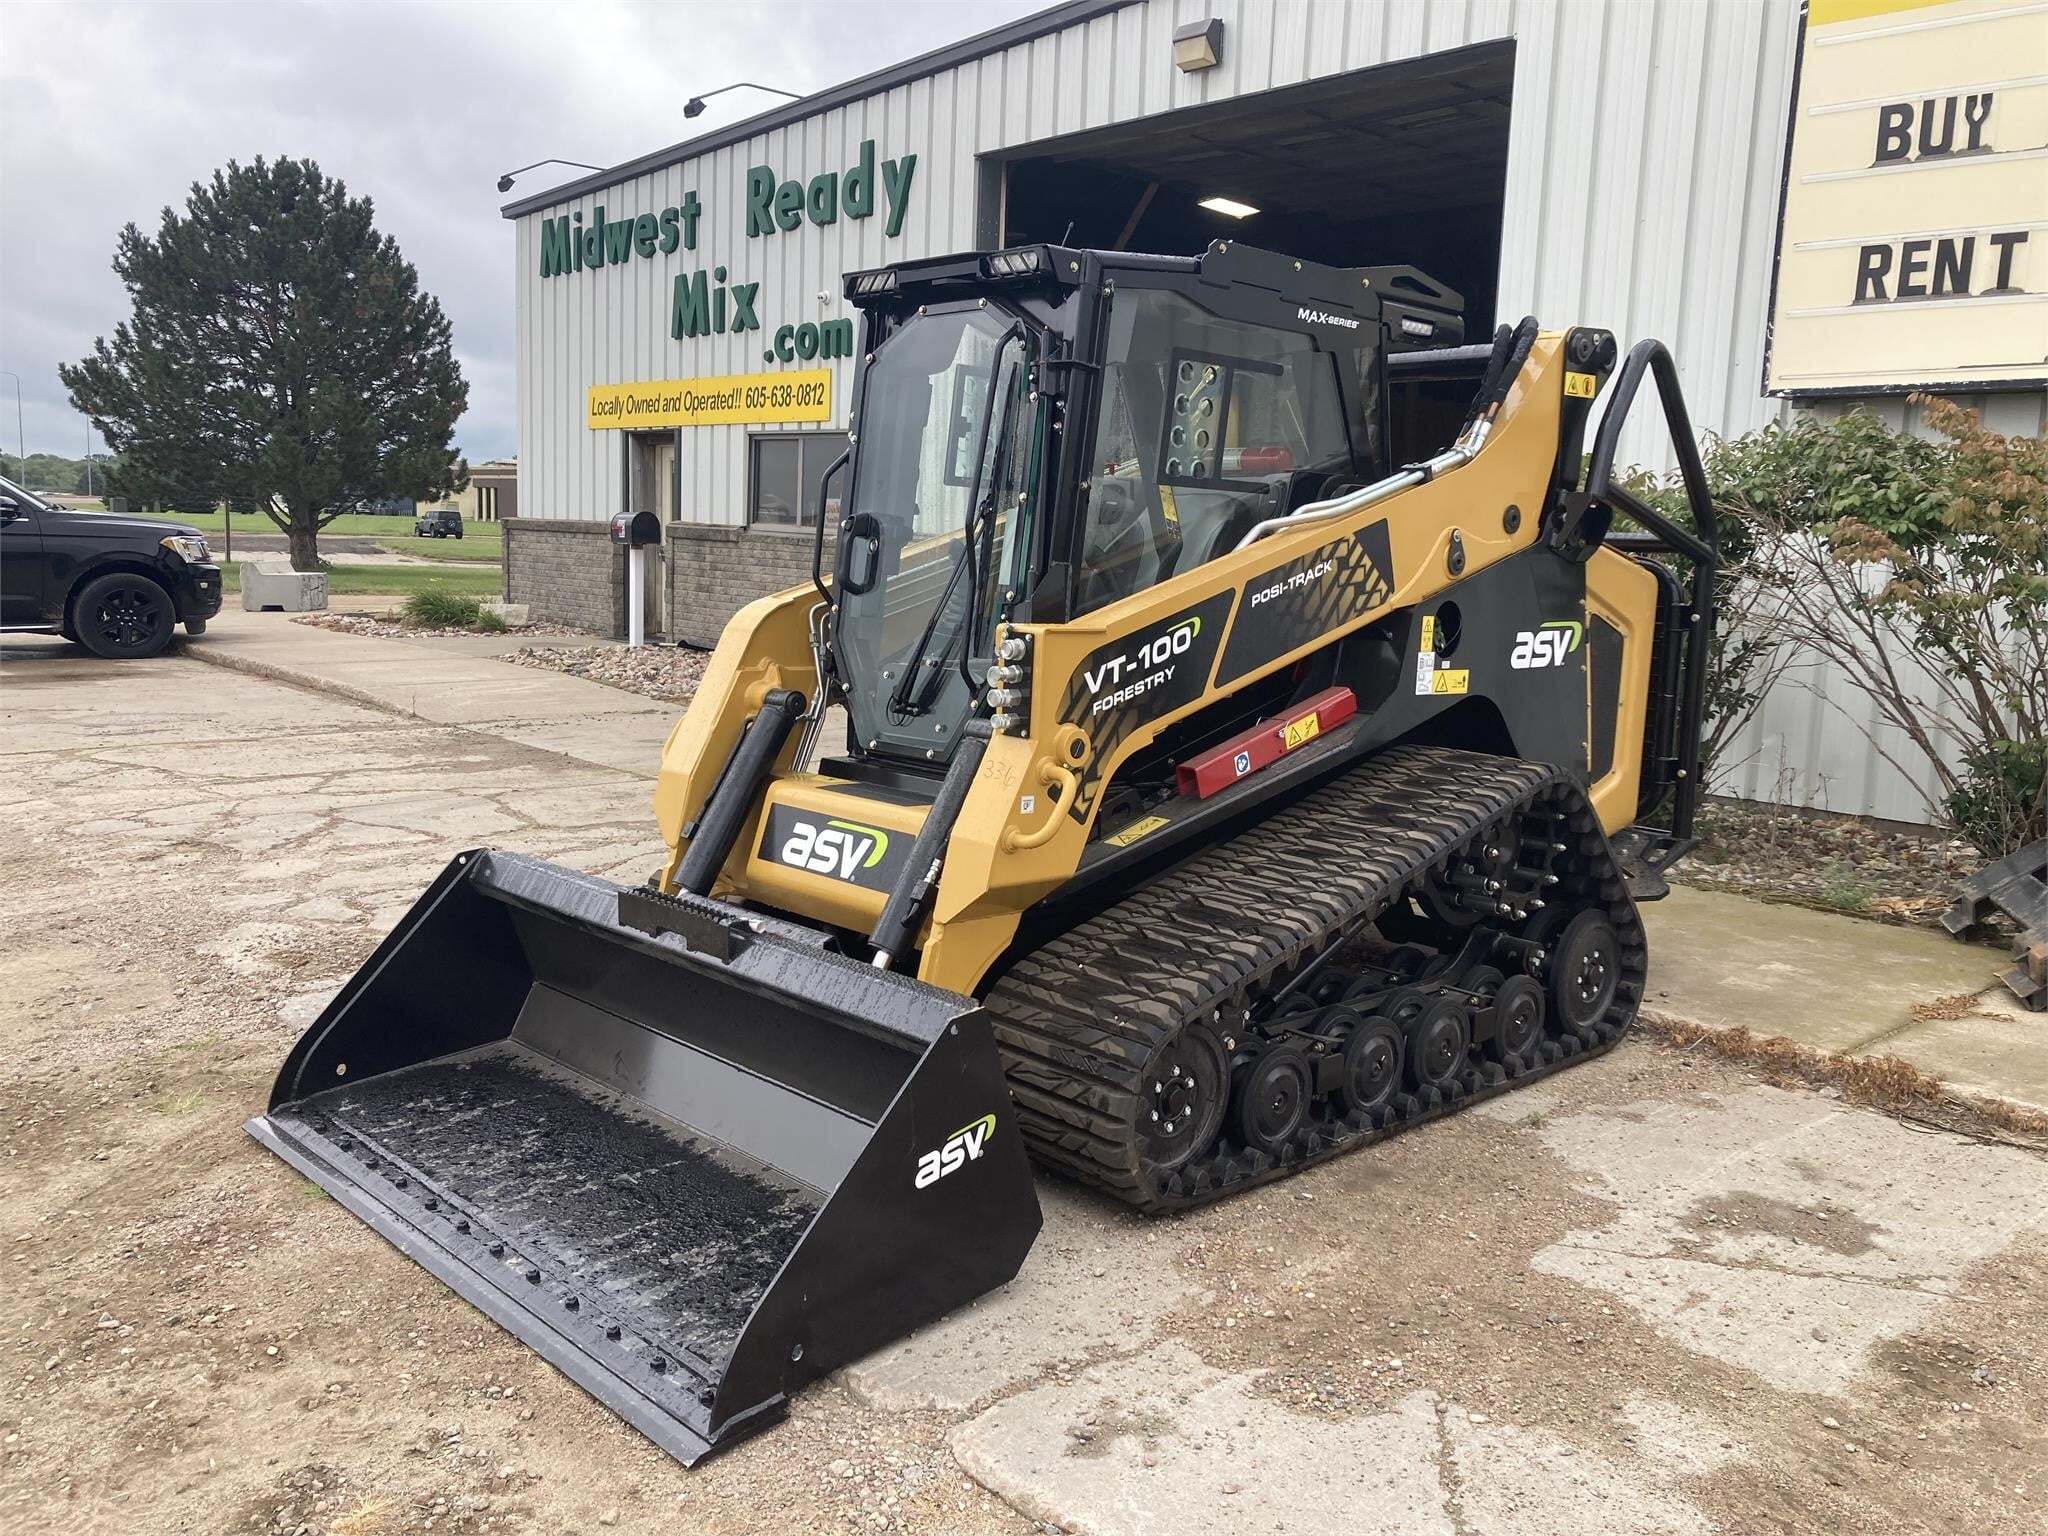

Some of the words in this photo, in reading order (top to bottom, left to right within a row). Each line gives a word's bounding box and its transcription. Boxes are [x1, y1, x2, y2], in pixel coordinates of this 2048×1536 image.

[1875, 92, 1994, 162] BUY
[540, 190, 701, 278] Midwest
[747, 139, 917, 238] Ready
[1853, 231, 2029, 301] RENT
[671, 266, 760, 340] Mix
[763, 317, 853, 364] .com
[592, 396, 625, 420] Locally
[626, 393, 660, 415] Owned
[663, 391, 681, 413] and
[684, 388, 742, 418] Operated!!
[745, 382, 825, 409] 605-638-0812
[1251, 559, 1333, 608] POSI-TRACK
[1083, 626, 1191, 694] VT-100
[1092, 664, 1175, 716] FORESTRY
